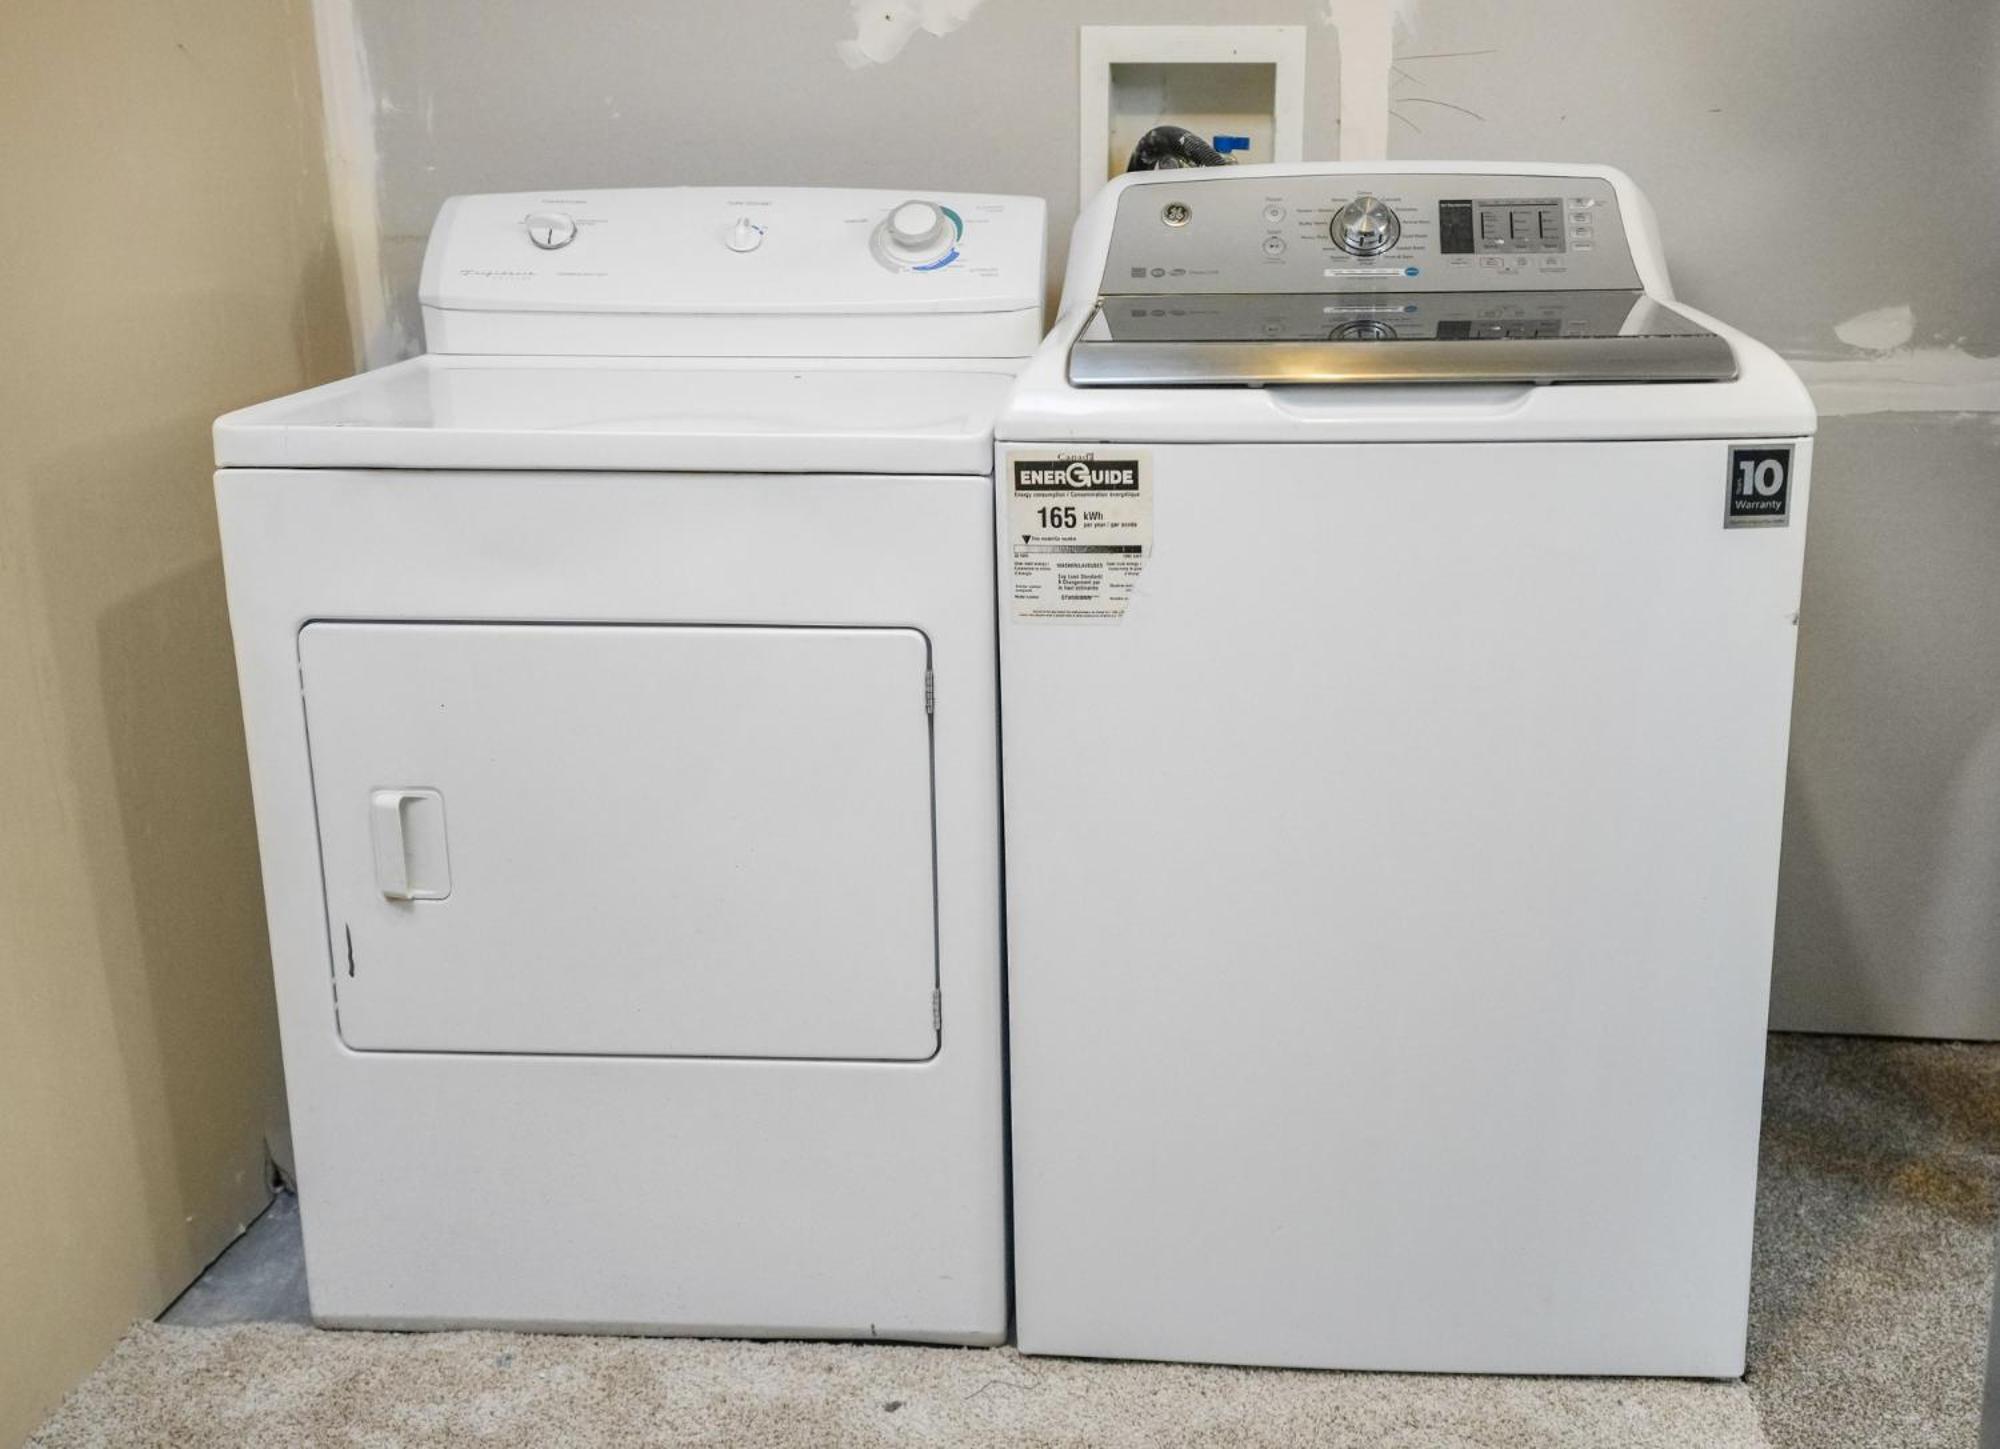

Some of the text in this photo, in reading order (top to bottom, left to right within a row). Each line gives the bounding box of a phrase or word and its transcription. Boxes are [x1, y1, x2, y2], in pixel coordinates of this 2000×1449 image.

[1020, 462, 1134, 488] ENERGUIDE
[1740, 459, 1784, 496] 10
[1037, 506, 1077, 529] 165
[1083, 511, 1103, 521] kWh
[1735, 500, 1782, 512] Warranty
